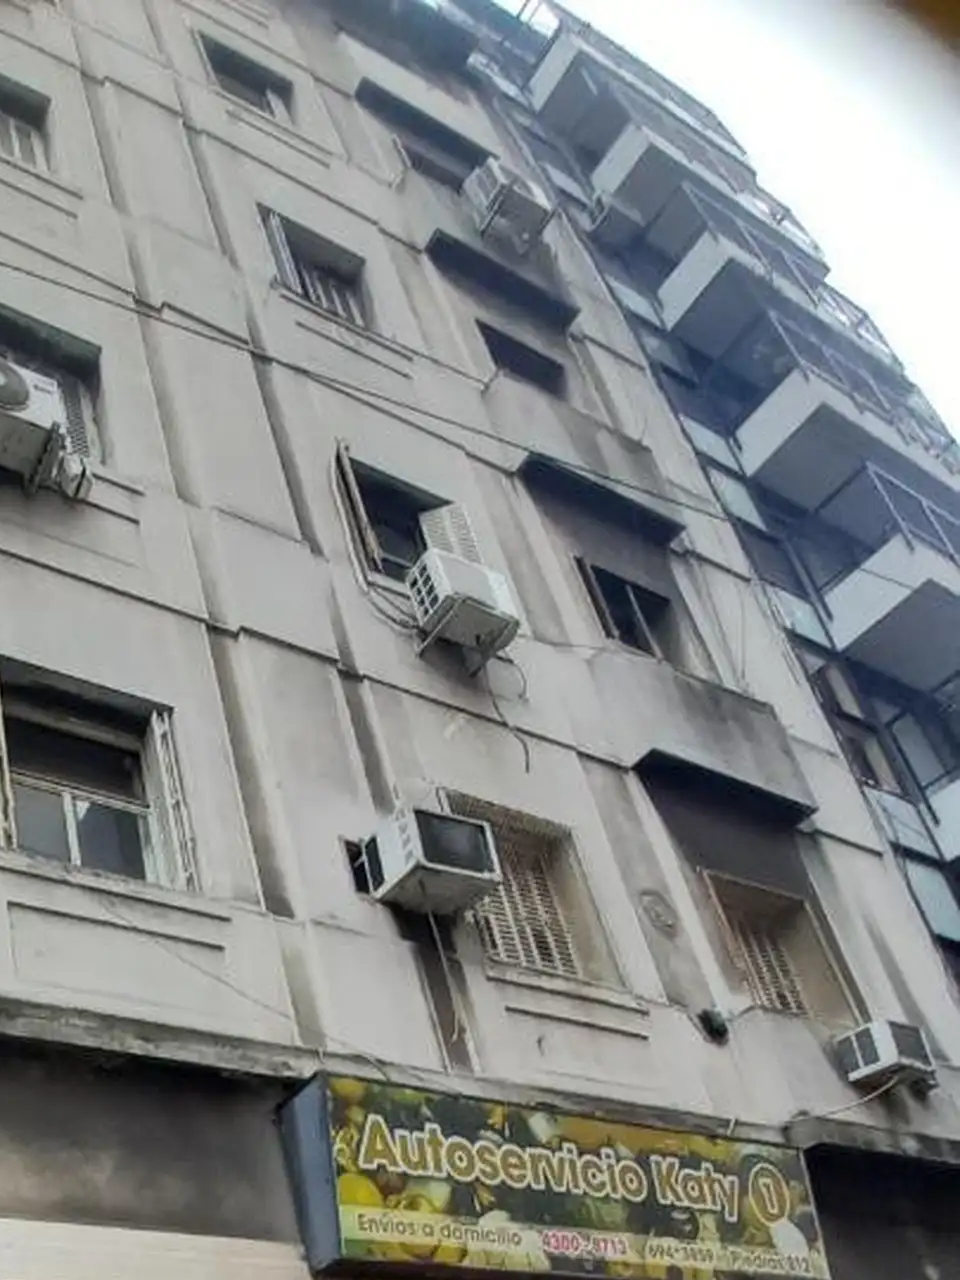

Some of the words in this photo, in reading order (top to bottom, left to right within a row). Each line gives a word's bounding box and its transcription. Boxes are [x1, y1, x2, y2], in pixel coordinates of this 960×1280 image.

[359, 1113, 647, 1202] Autoservicio
[651, 1155, 737, 1222] Katy
[440, 1221, 522, 1247] domicilio
